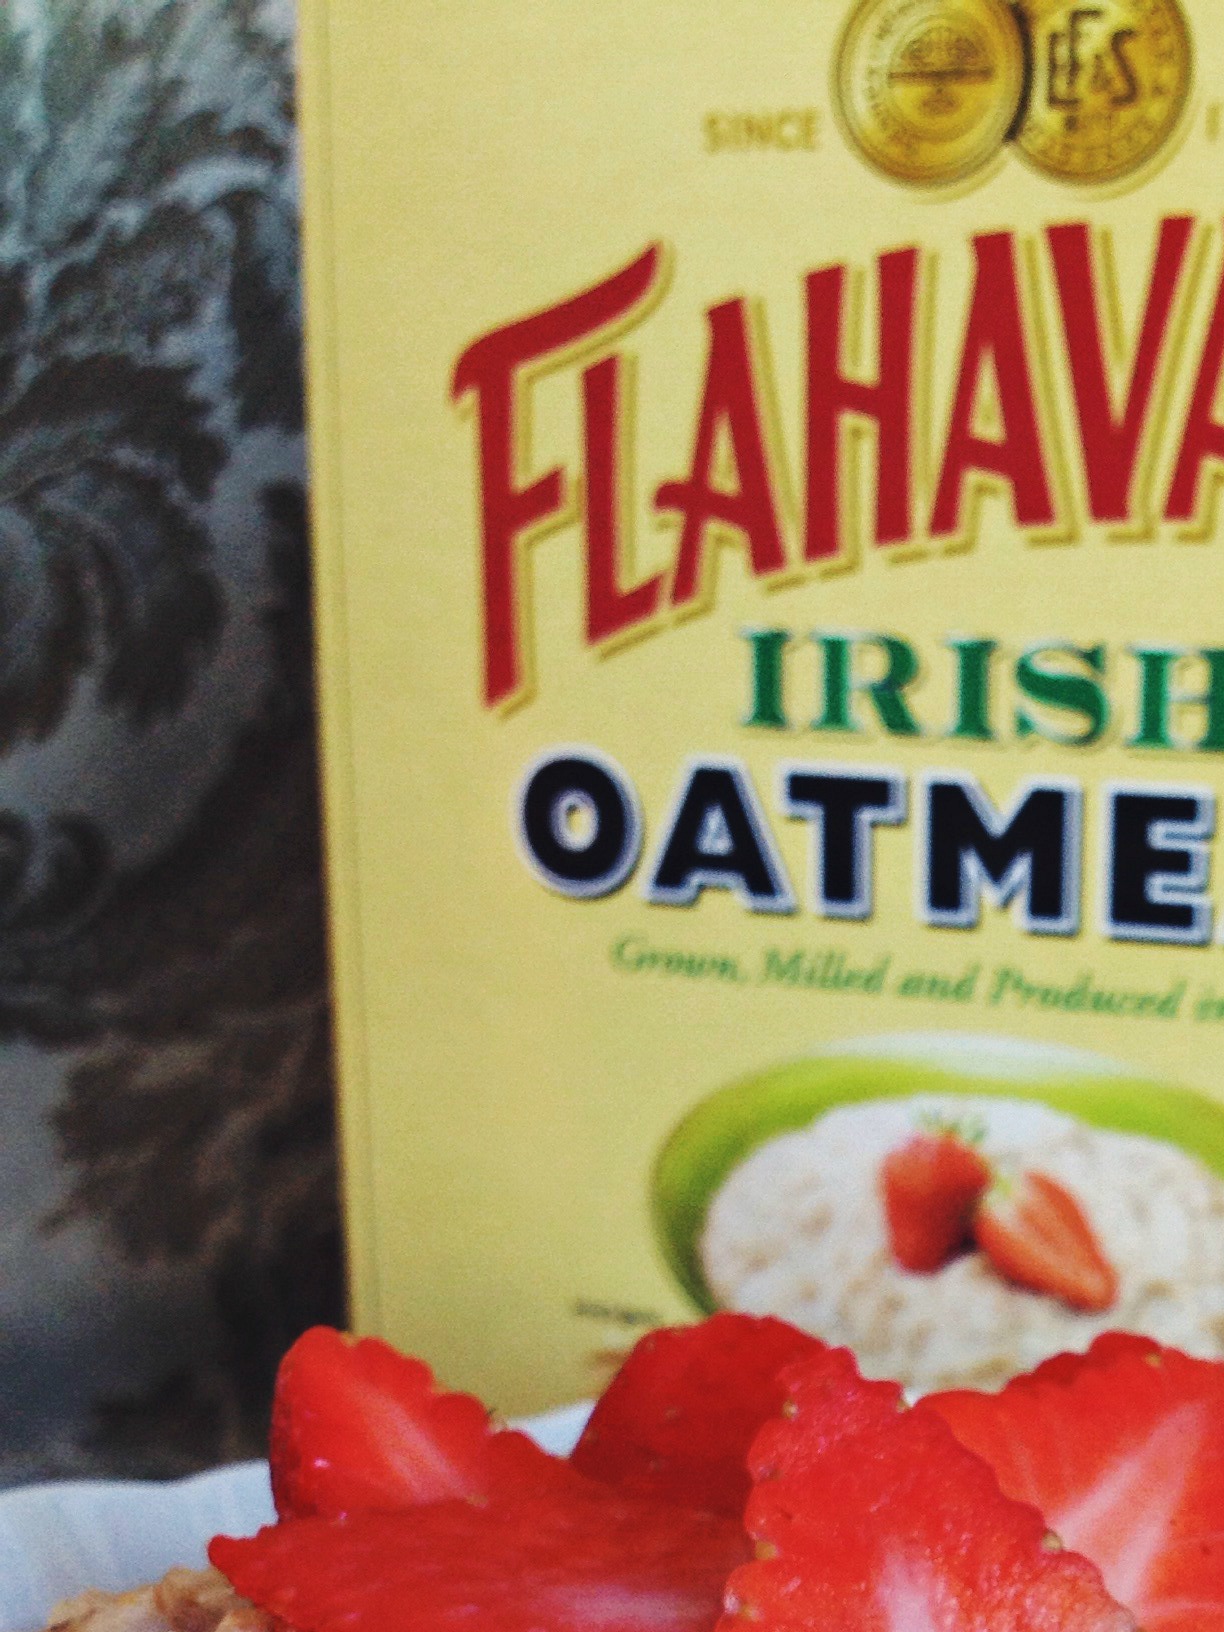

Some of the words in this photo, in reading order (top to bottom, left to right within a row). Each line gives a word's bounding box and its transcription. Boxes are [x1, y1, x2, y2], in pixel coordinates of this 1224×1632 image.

[703, 107, 819, 154] SINCE
[761, 946, 893, 993] Milled
[897, 961, 982, 1004] and
[987, 966, 1188, 1020] Produced
